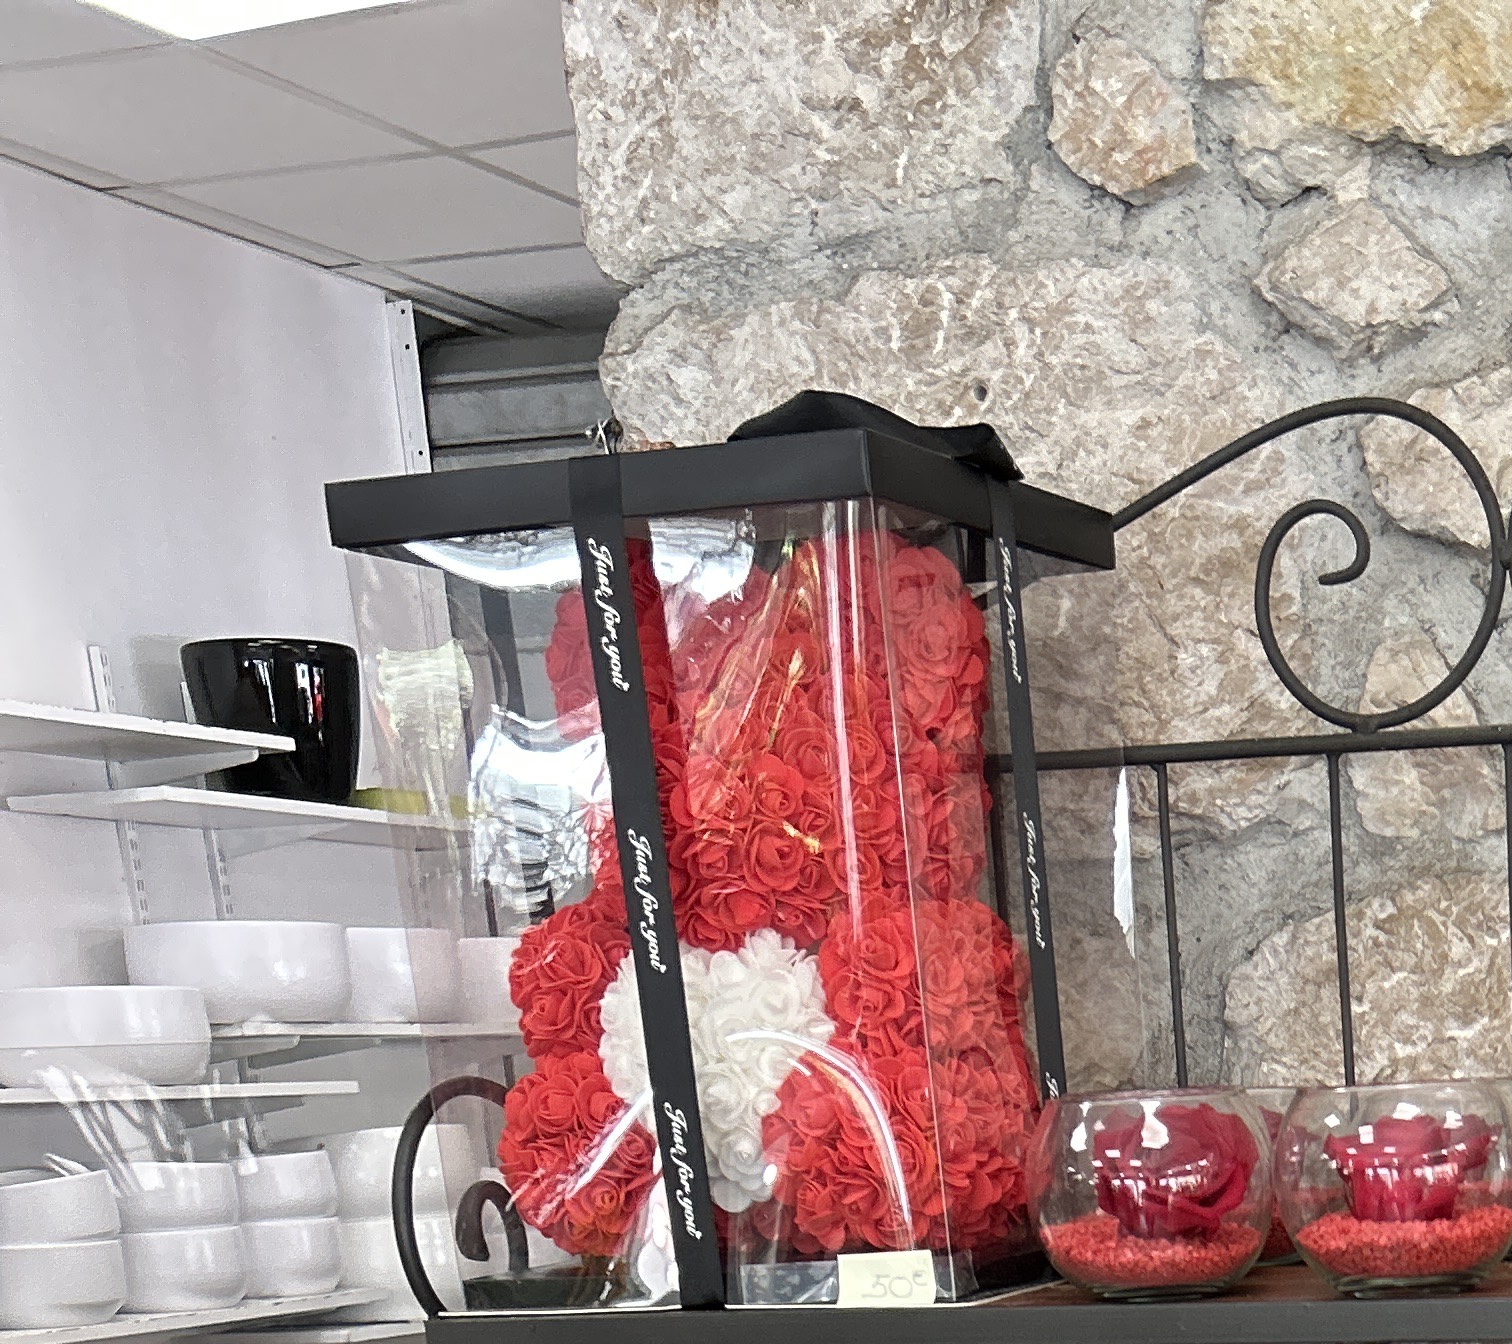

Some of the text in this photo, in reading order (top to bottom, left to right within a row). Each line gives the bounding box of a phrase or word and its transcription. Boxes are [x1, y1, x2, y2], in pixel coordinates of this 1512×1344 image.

[587, 537, 630, 692] Just for you
[627, 828, 667, 974] Just for you
[663, 1101, 703, 1240] Just for you
[861, 1269, 930, 1299] 50€
